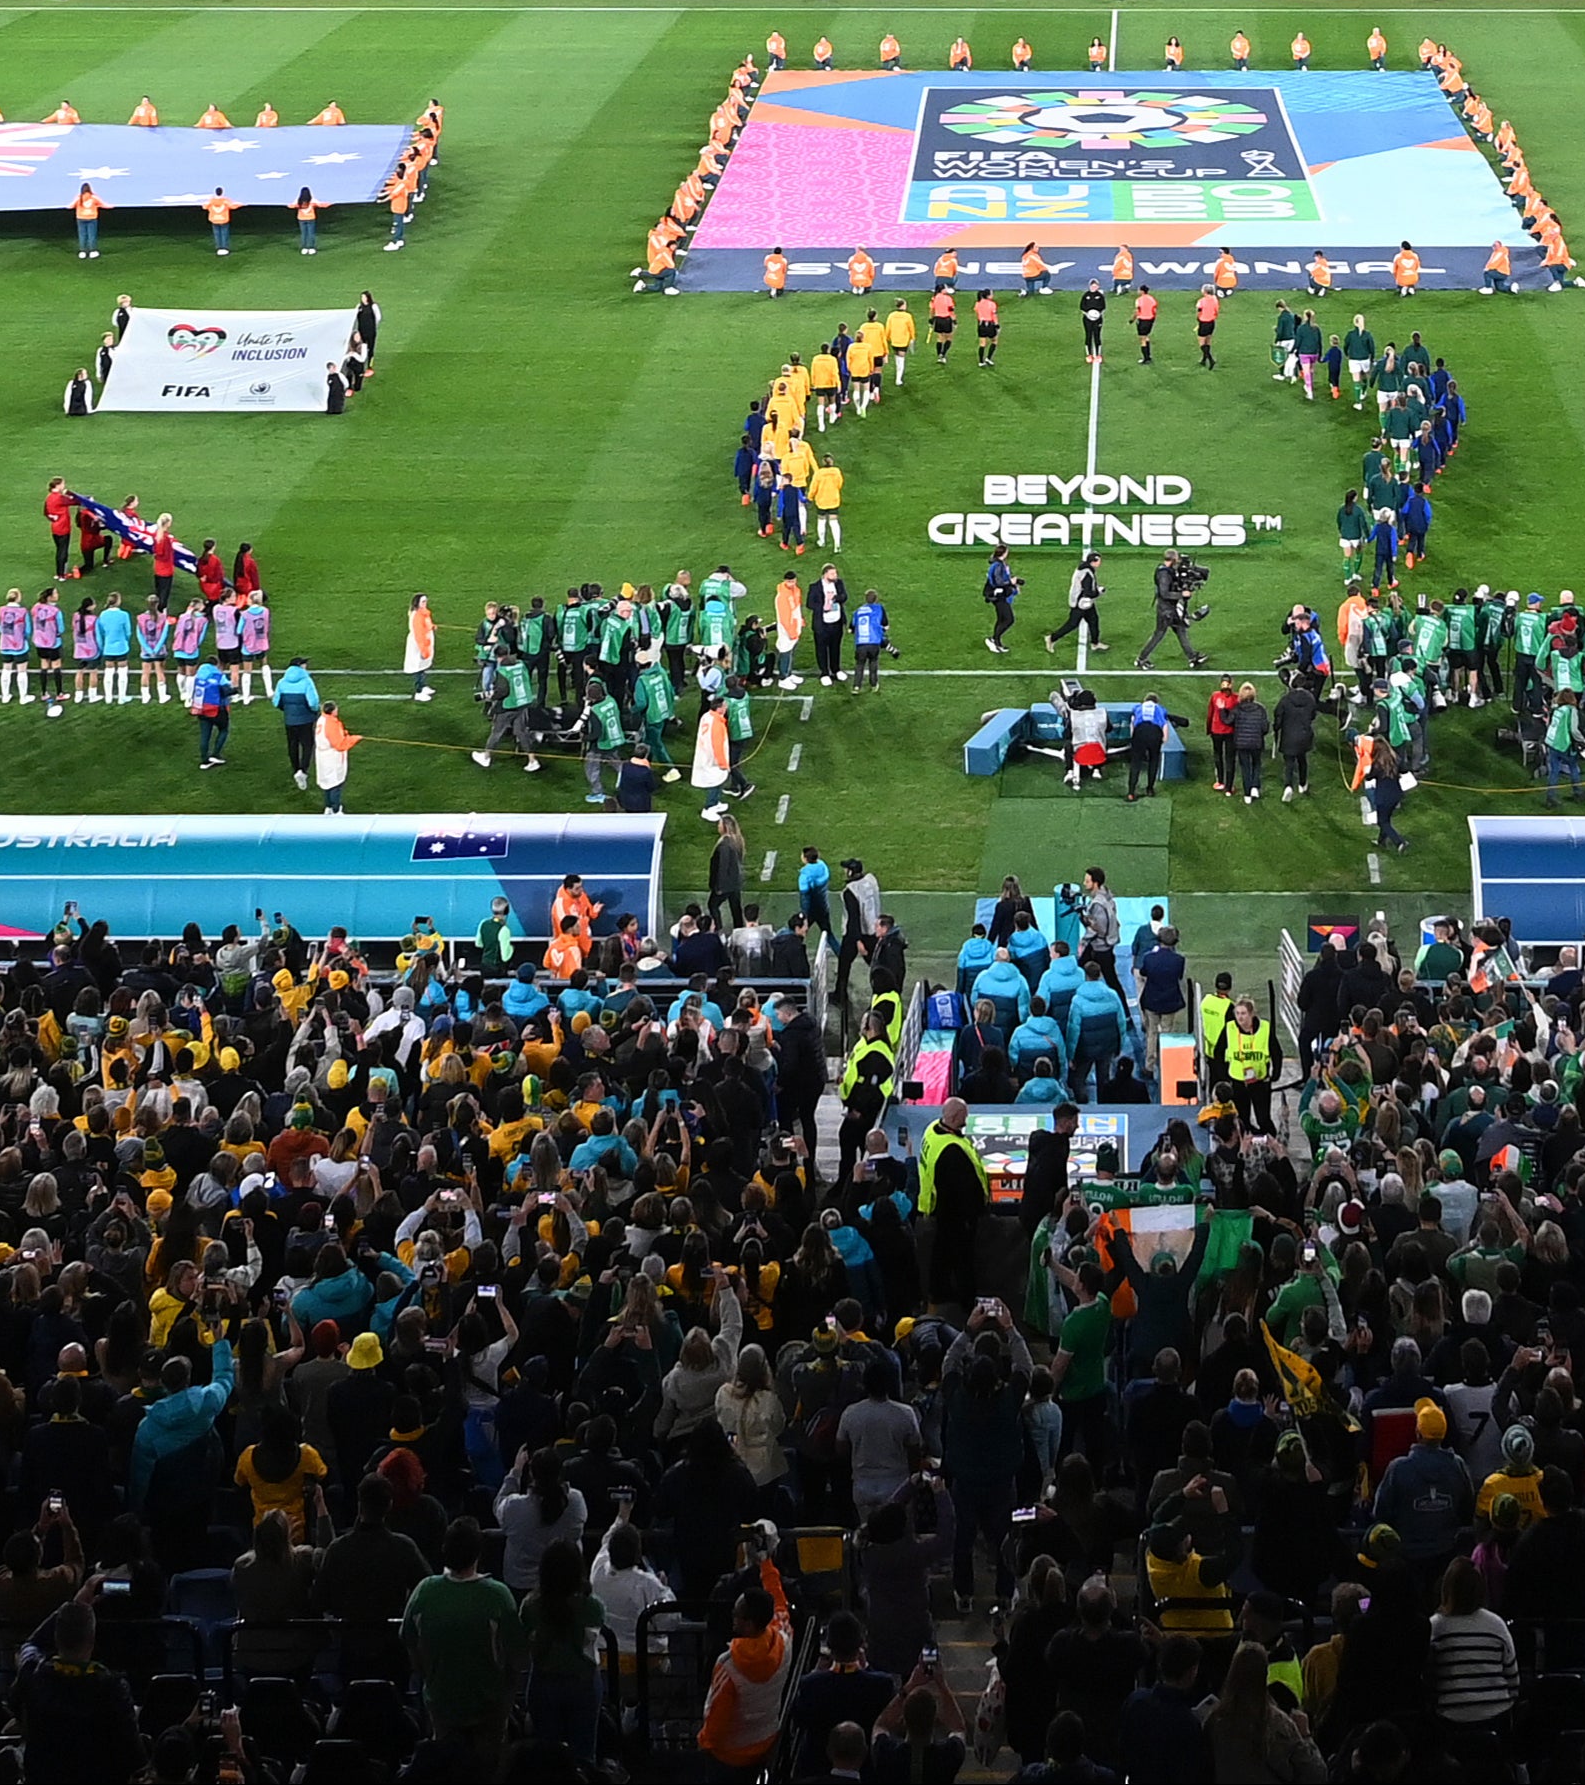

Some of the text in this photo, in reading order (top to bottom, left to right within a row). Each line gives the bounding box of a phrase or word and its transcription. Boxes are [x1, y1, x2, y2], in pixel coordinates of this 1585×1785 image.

[933, 151, 1057, 162] FIFA
[934, 160, 1177, 170] WOMEN'S
[932, 168, 1229, 179] WORLD CUP
[930, 183, 1090, 201] AU
[929, 200, 1090, 219] NZ
[236, 332, 274, 347] Unite
[231, 346, 308, 362] INCLUSION
[161, 384, 214, 398] FIFA
[983, 473, 1192, 506] BEYOND
[1468, 1411, 1490, 1446] 7
